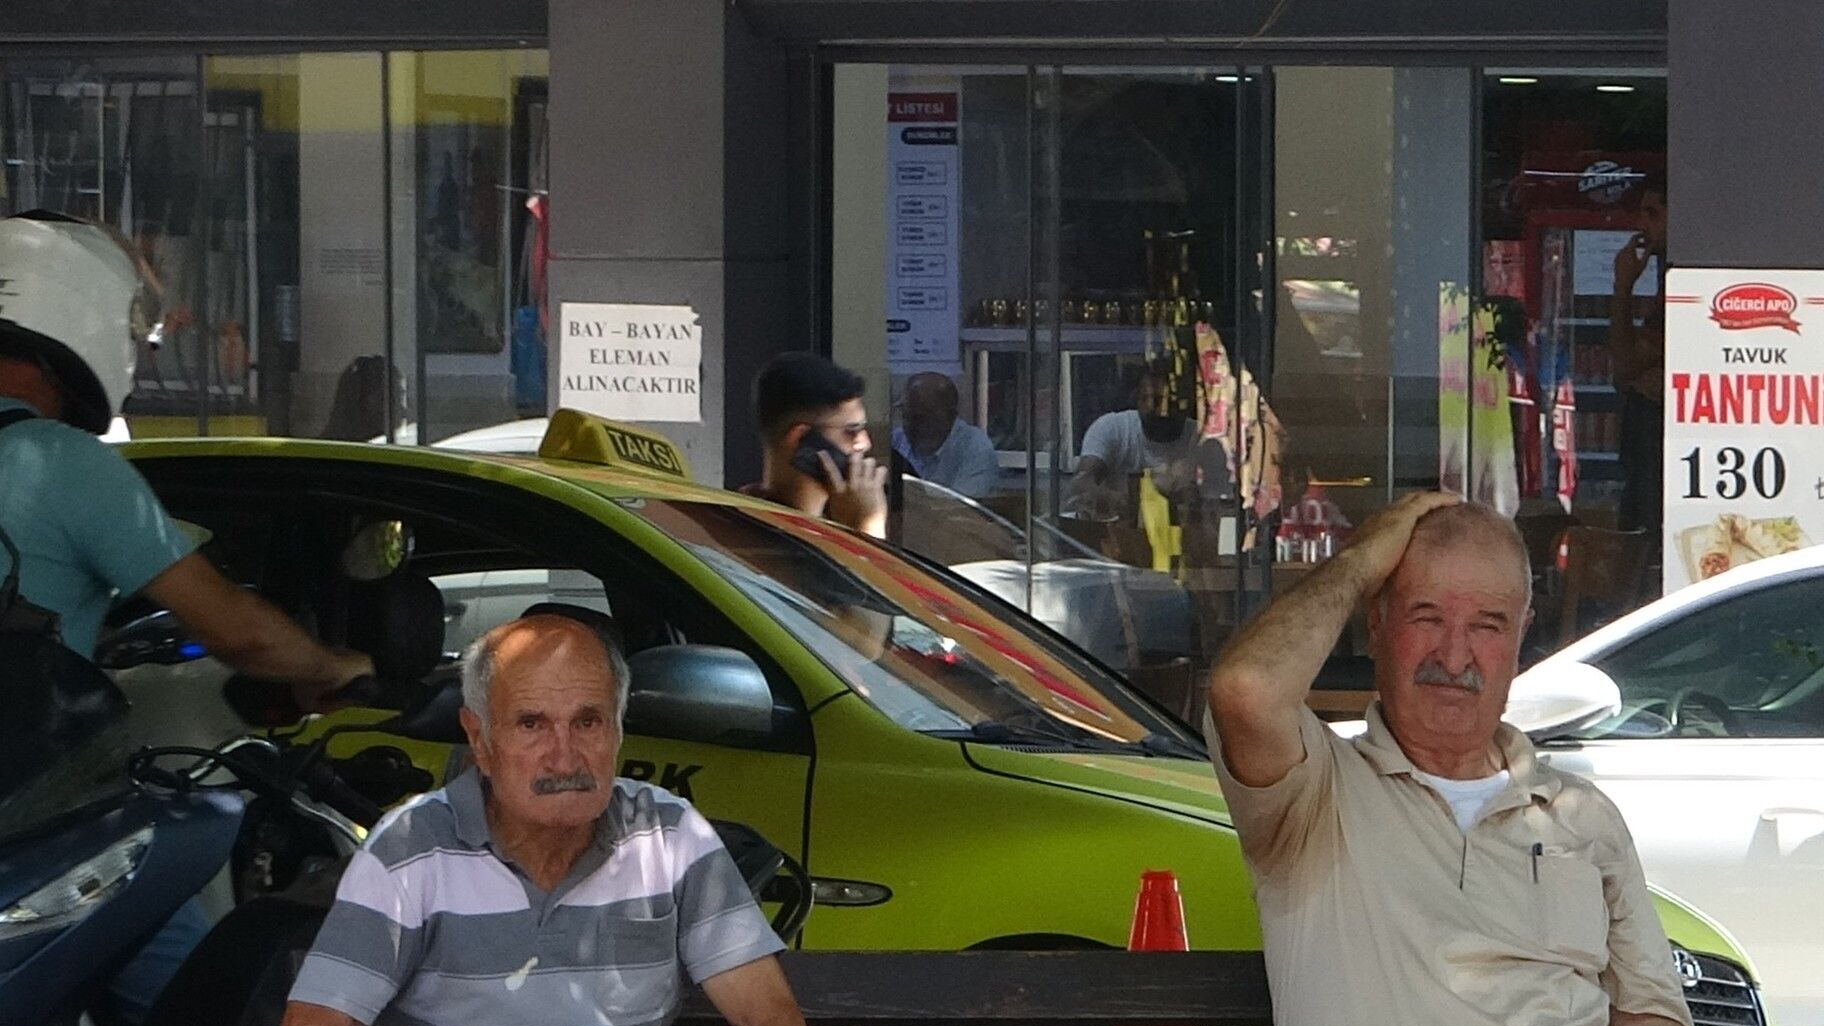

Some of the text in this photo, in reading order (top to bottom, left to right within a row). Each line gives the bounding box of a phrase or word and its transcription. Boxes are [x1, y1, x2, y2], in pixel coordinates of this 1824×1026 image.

[1766, 299, 1790, 312] APO
[569, 321, 607, 338] BAY
[626, 322, 693, 340] BAYAN
[590, 348, 671, 366] ELEMAN
[1721, 347, 1788, 365] TAVUK
[562, 375, 697, 395] ALINACAKTIR
[1679, 446, 1787, 500] 130
